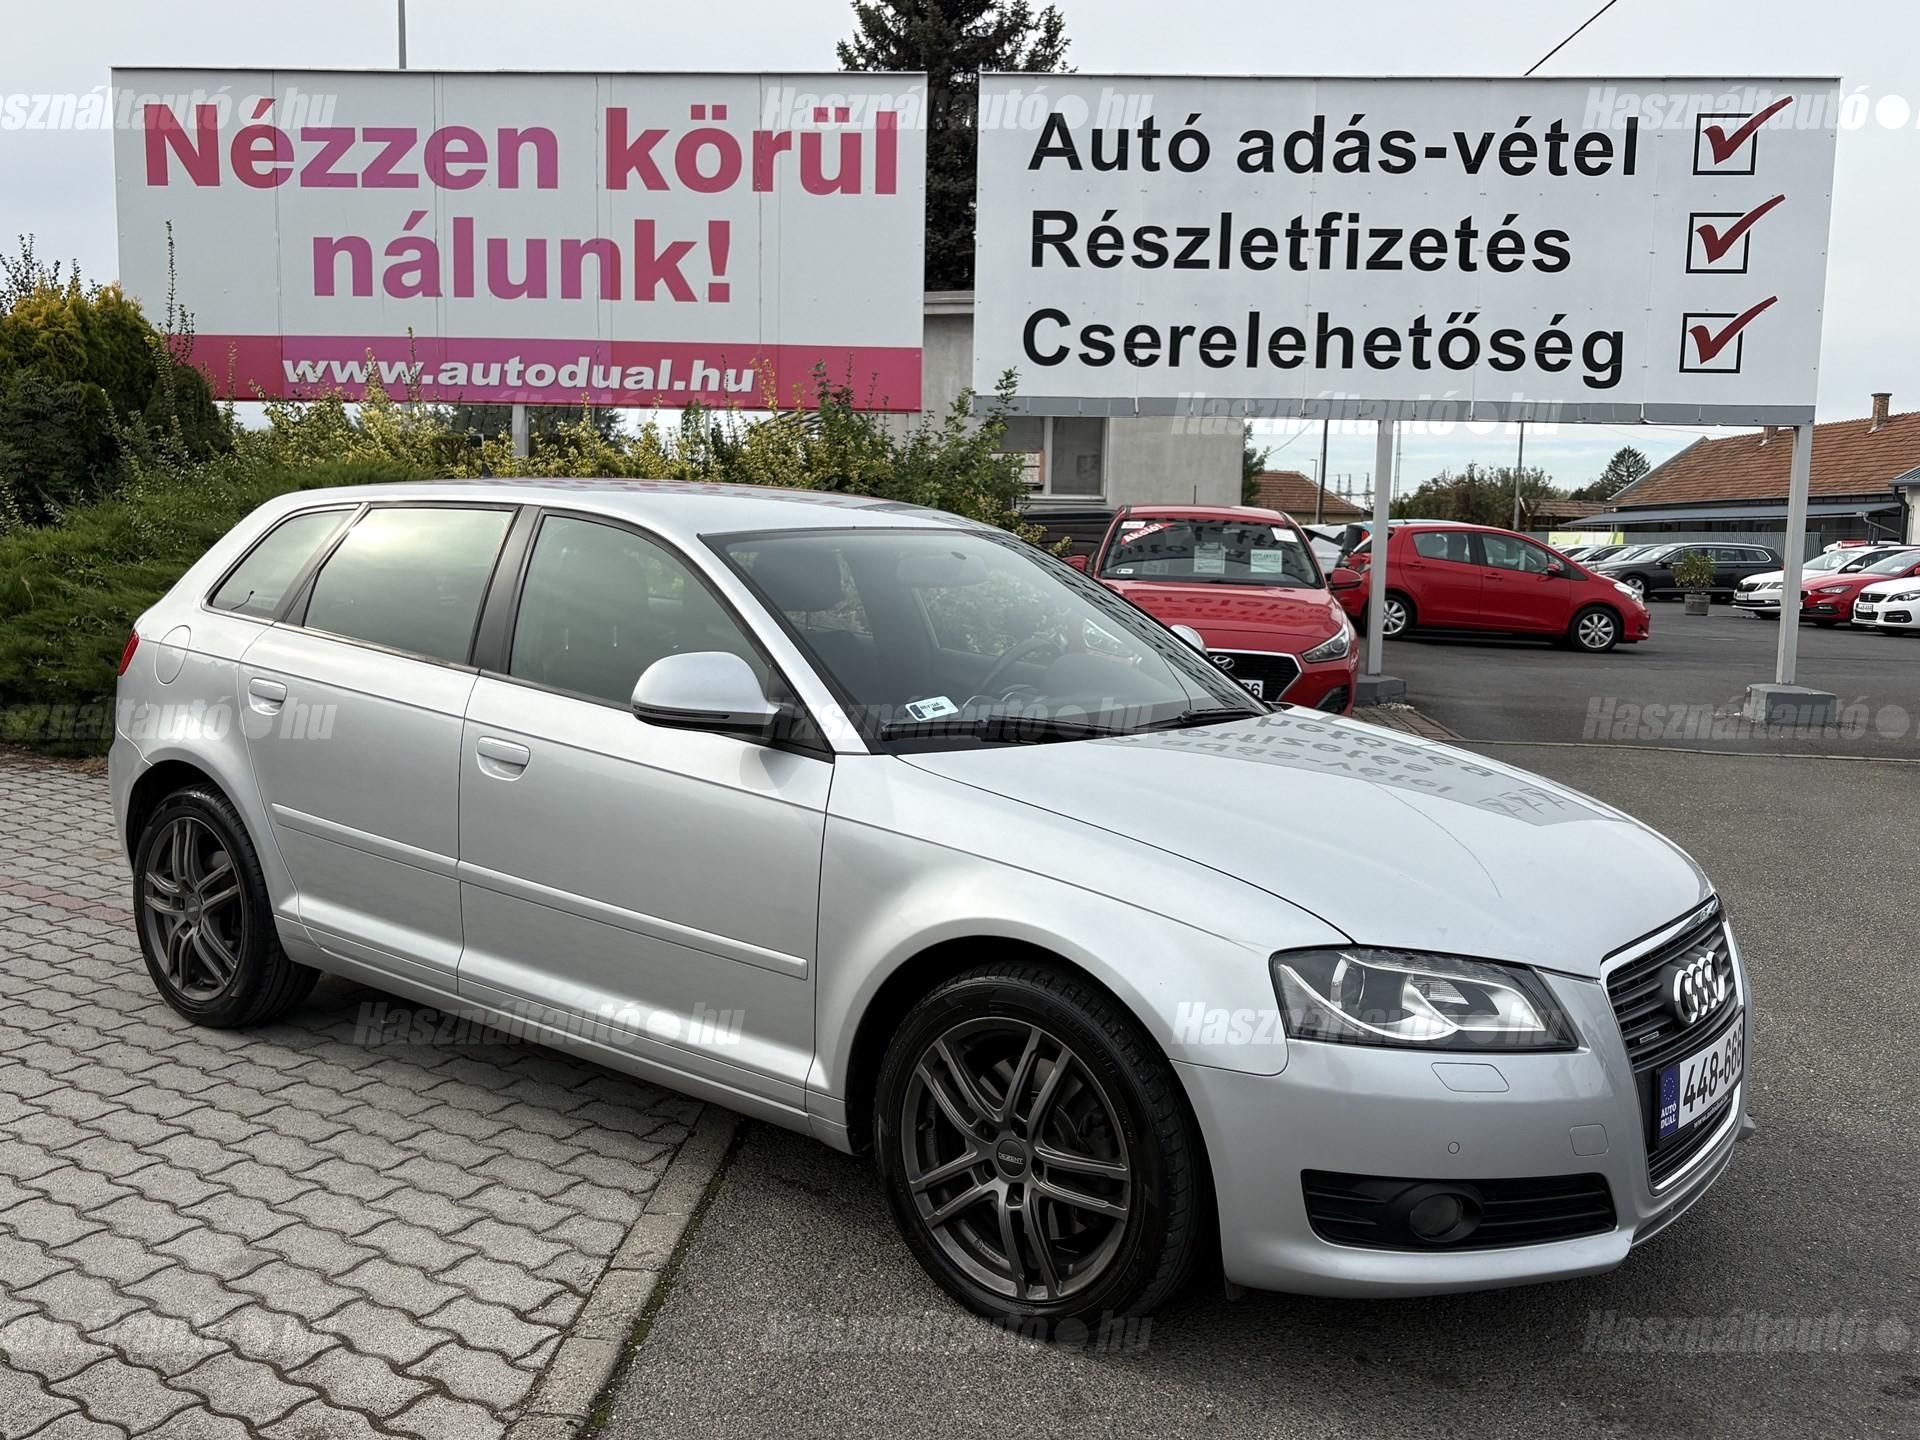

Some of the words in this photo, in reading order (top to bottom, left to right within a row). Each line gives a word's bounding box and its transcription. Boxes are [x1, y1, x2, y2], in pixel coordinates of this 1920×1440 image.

[143, 97, 559, 190] Nézzen
[606, 104, 898, 195] körül
[1027, 112, 1210, 173] Autó
[1236, 113, 1639, 176] adás-vétel
[312, 210, 730, 303] nálunk!
[1030, 209, 1571, 272] Részletfizetés
[282, 355, 757, 393] www.autodual.hu
[1022, 307, 1624, 389] Cserelehetőség
[1123, 522, 1164, 542] Akció!
[1683, 1022, 1742, 1113] 448-666
